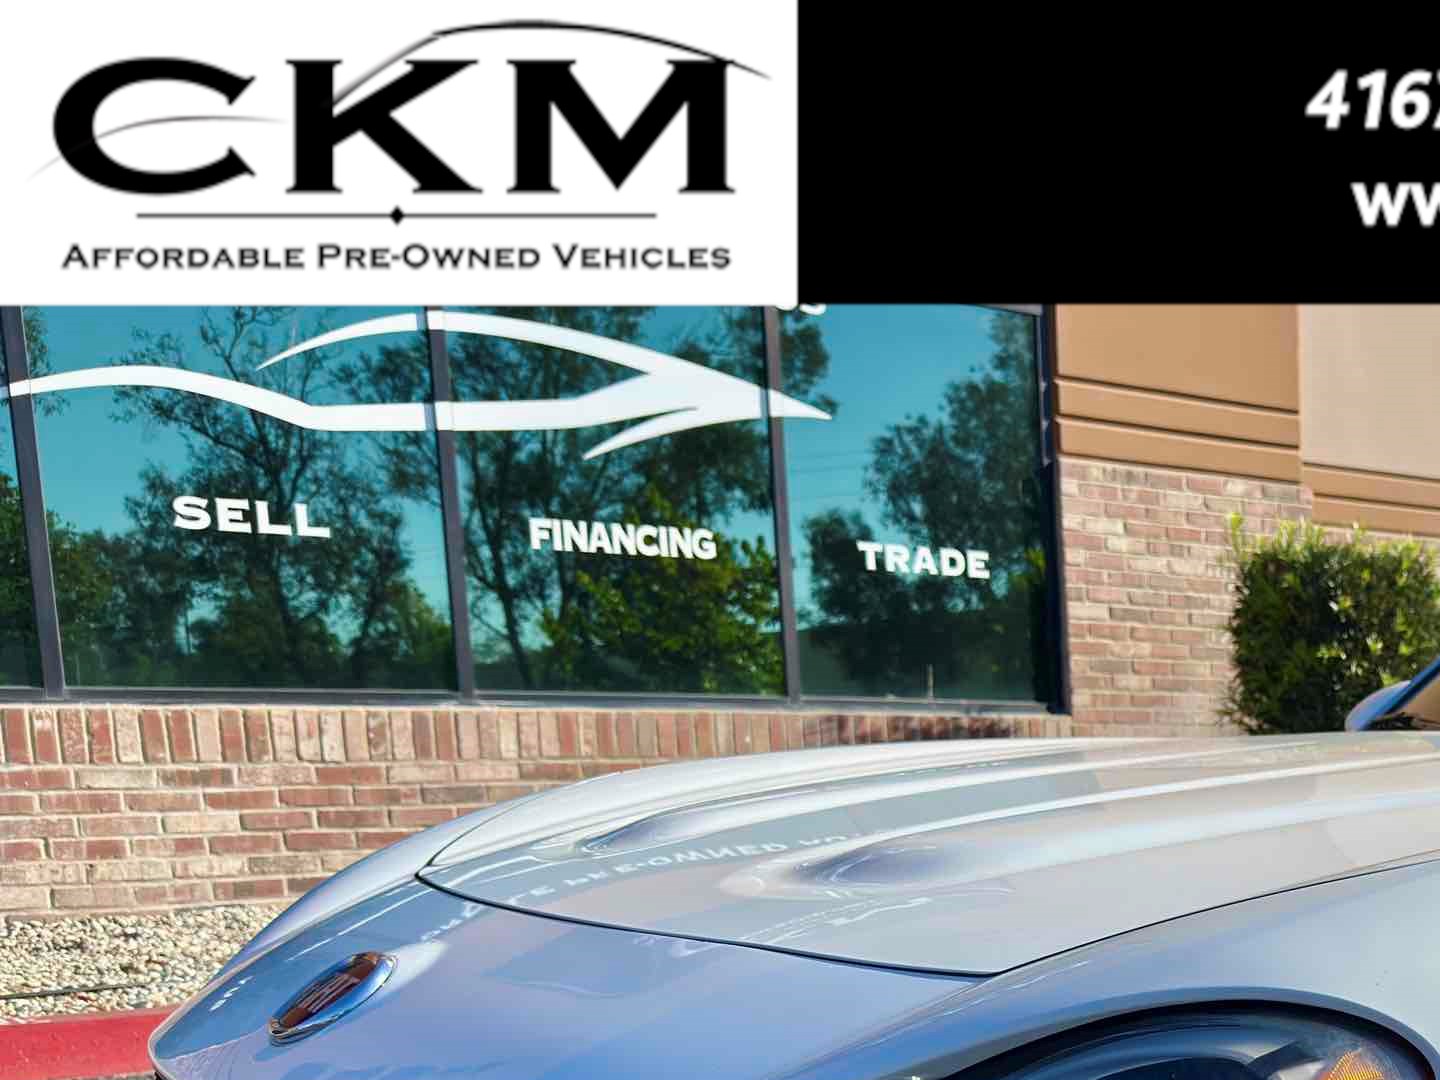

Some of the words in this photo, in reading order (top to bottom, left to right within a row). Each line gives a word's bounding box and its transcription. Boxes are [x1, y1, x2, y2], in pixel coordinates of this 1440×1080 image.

[172, 495, 331, 539] SELL
[528, 516, 717, 561] FINANCING
[856, 540, 991, 579] TRADE
